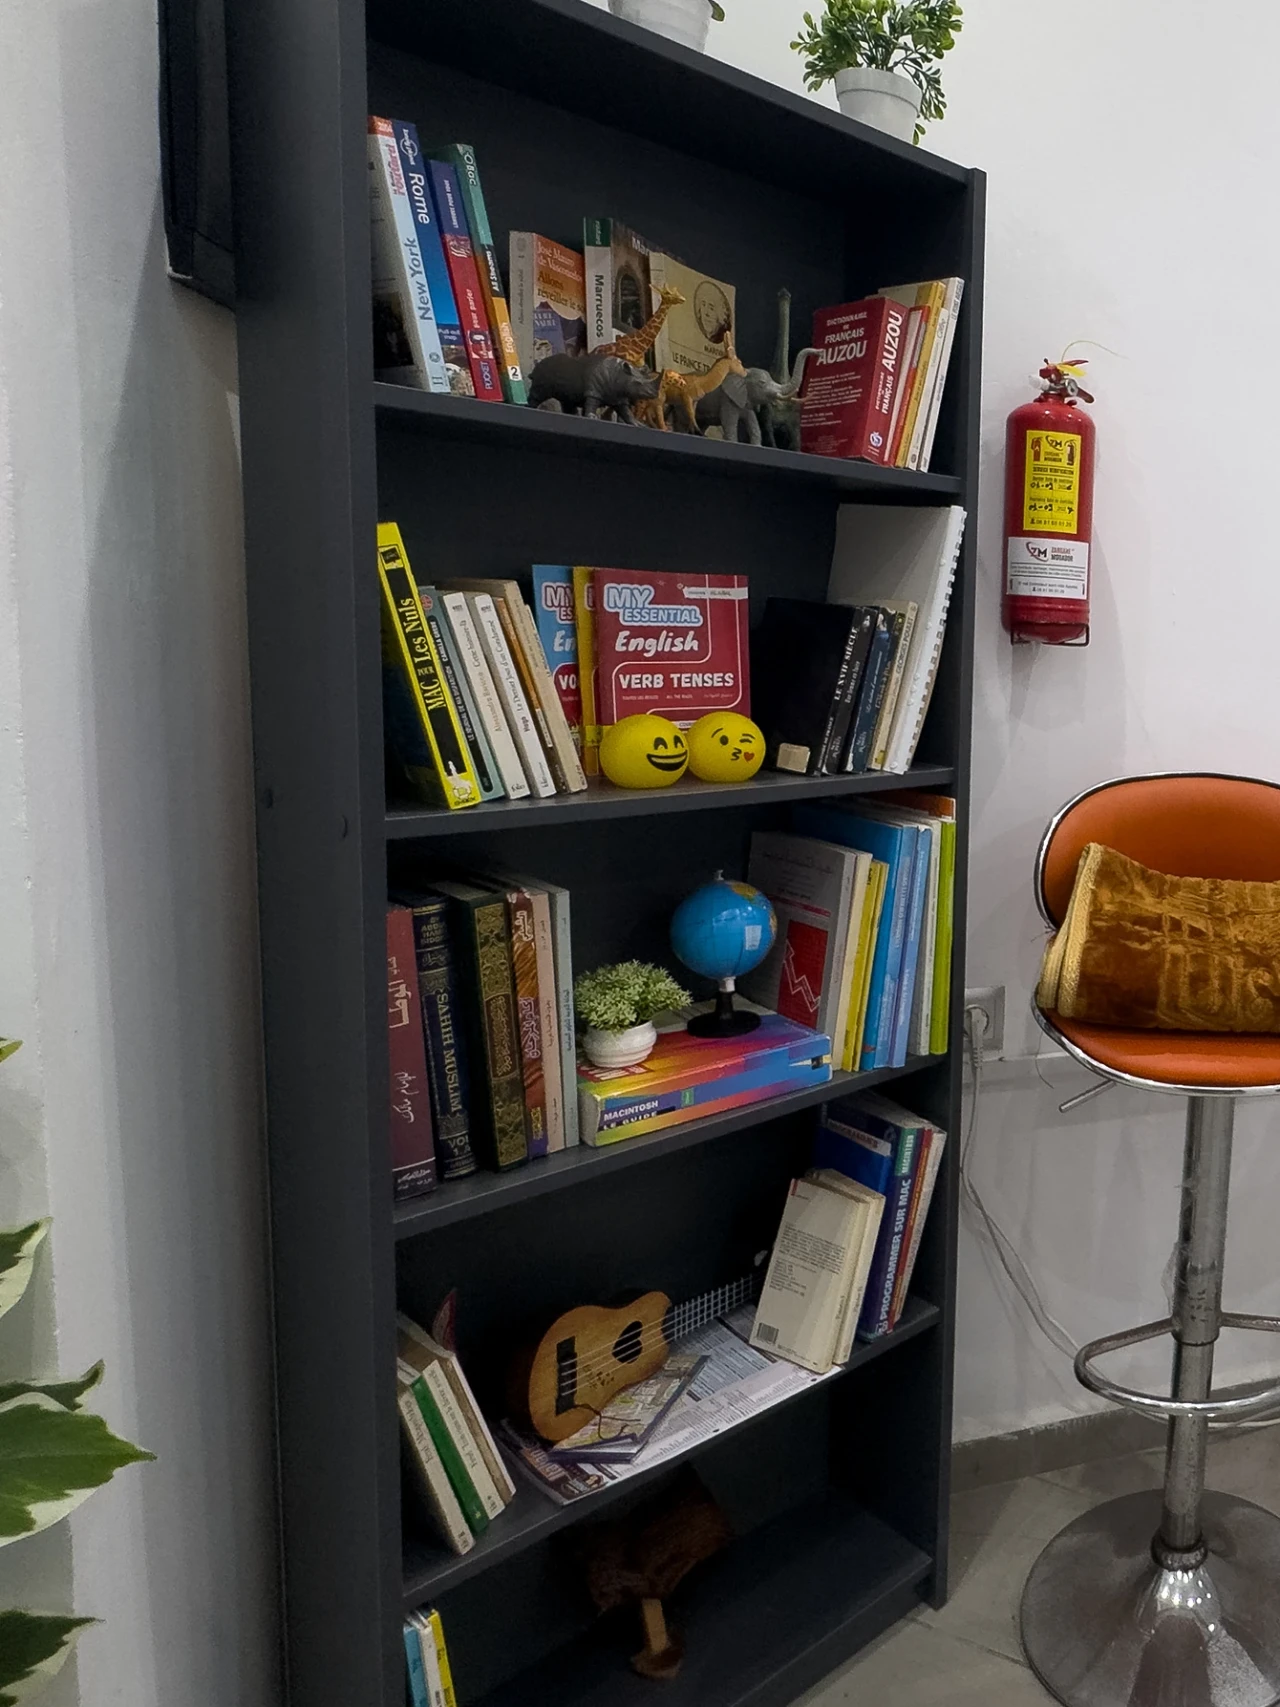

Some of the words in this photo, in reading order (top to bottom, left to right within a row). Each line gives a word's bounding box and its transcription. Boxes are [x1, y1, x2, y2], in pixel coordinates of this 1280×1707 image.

[409, 172, 430, 225] Rome
[404, 237, 422, 277] York
[416, 281, 434, 321] New
[594, 274, 604, 338] Marruecos
[827, 312, 867, 326] DICTIONNAIRE
[504, 321, 513, 353] English
[825, 328, 864, 344] FRANÇAIS
[882, 310, 904, 372] AUZOU
[816, 340, 867, 366] AUZOU
[483, 361, 493, 391] POCKET
[510, 366, 518, 377] 2
[882, 375, 894, 414] FRANÇAIS
[605, 585, 652, 610] MY
[400, 598, 422, 637] Nuls
[623, 607, 701, 624] ESSENTIAL
[414, 636, 433, 664] Les
[615, 630, 699, 657] English
[833, 688, 841, 701] LE
[843, 626, 859, 660] SIÈCLE
[428, 678, 446, 711] MAC
[618, 673, 664, 689] VERB
[670, 672, 734, 688] TENSES
[519, 715, 531, 732] Hugo
[437, 993, 454, 1046] SAHIH
[442, 1048, 462, 1113] MUSLIM
[604, 1100, 659, 1122] MACINTOSH
[902, 1134, 914, 1174] MACINTOSH
[899, 1178, 912, 1208] MAC
[896, 1208, 906, 1234] SUR
[880, 1235, 901, 1320] PROGRAMMER
